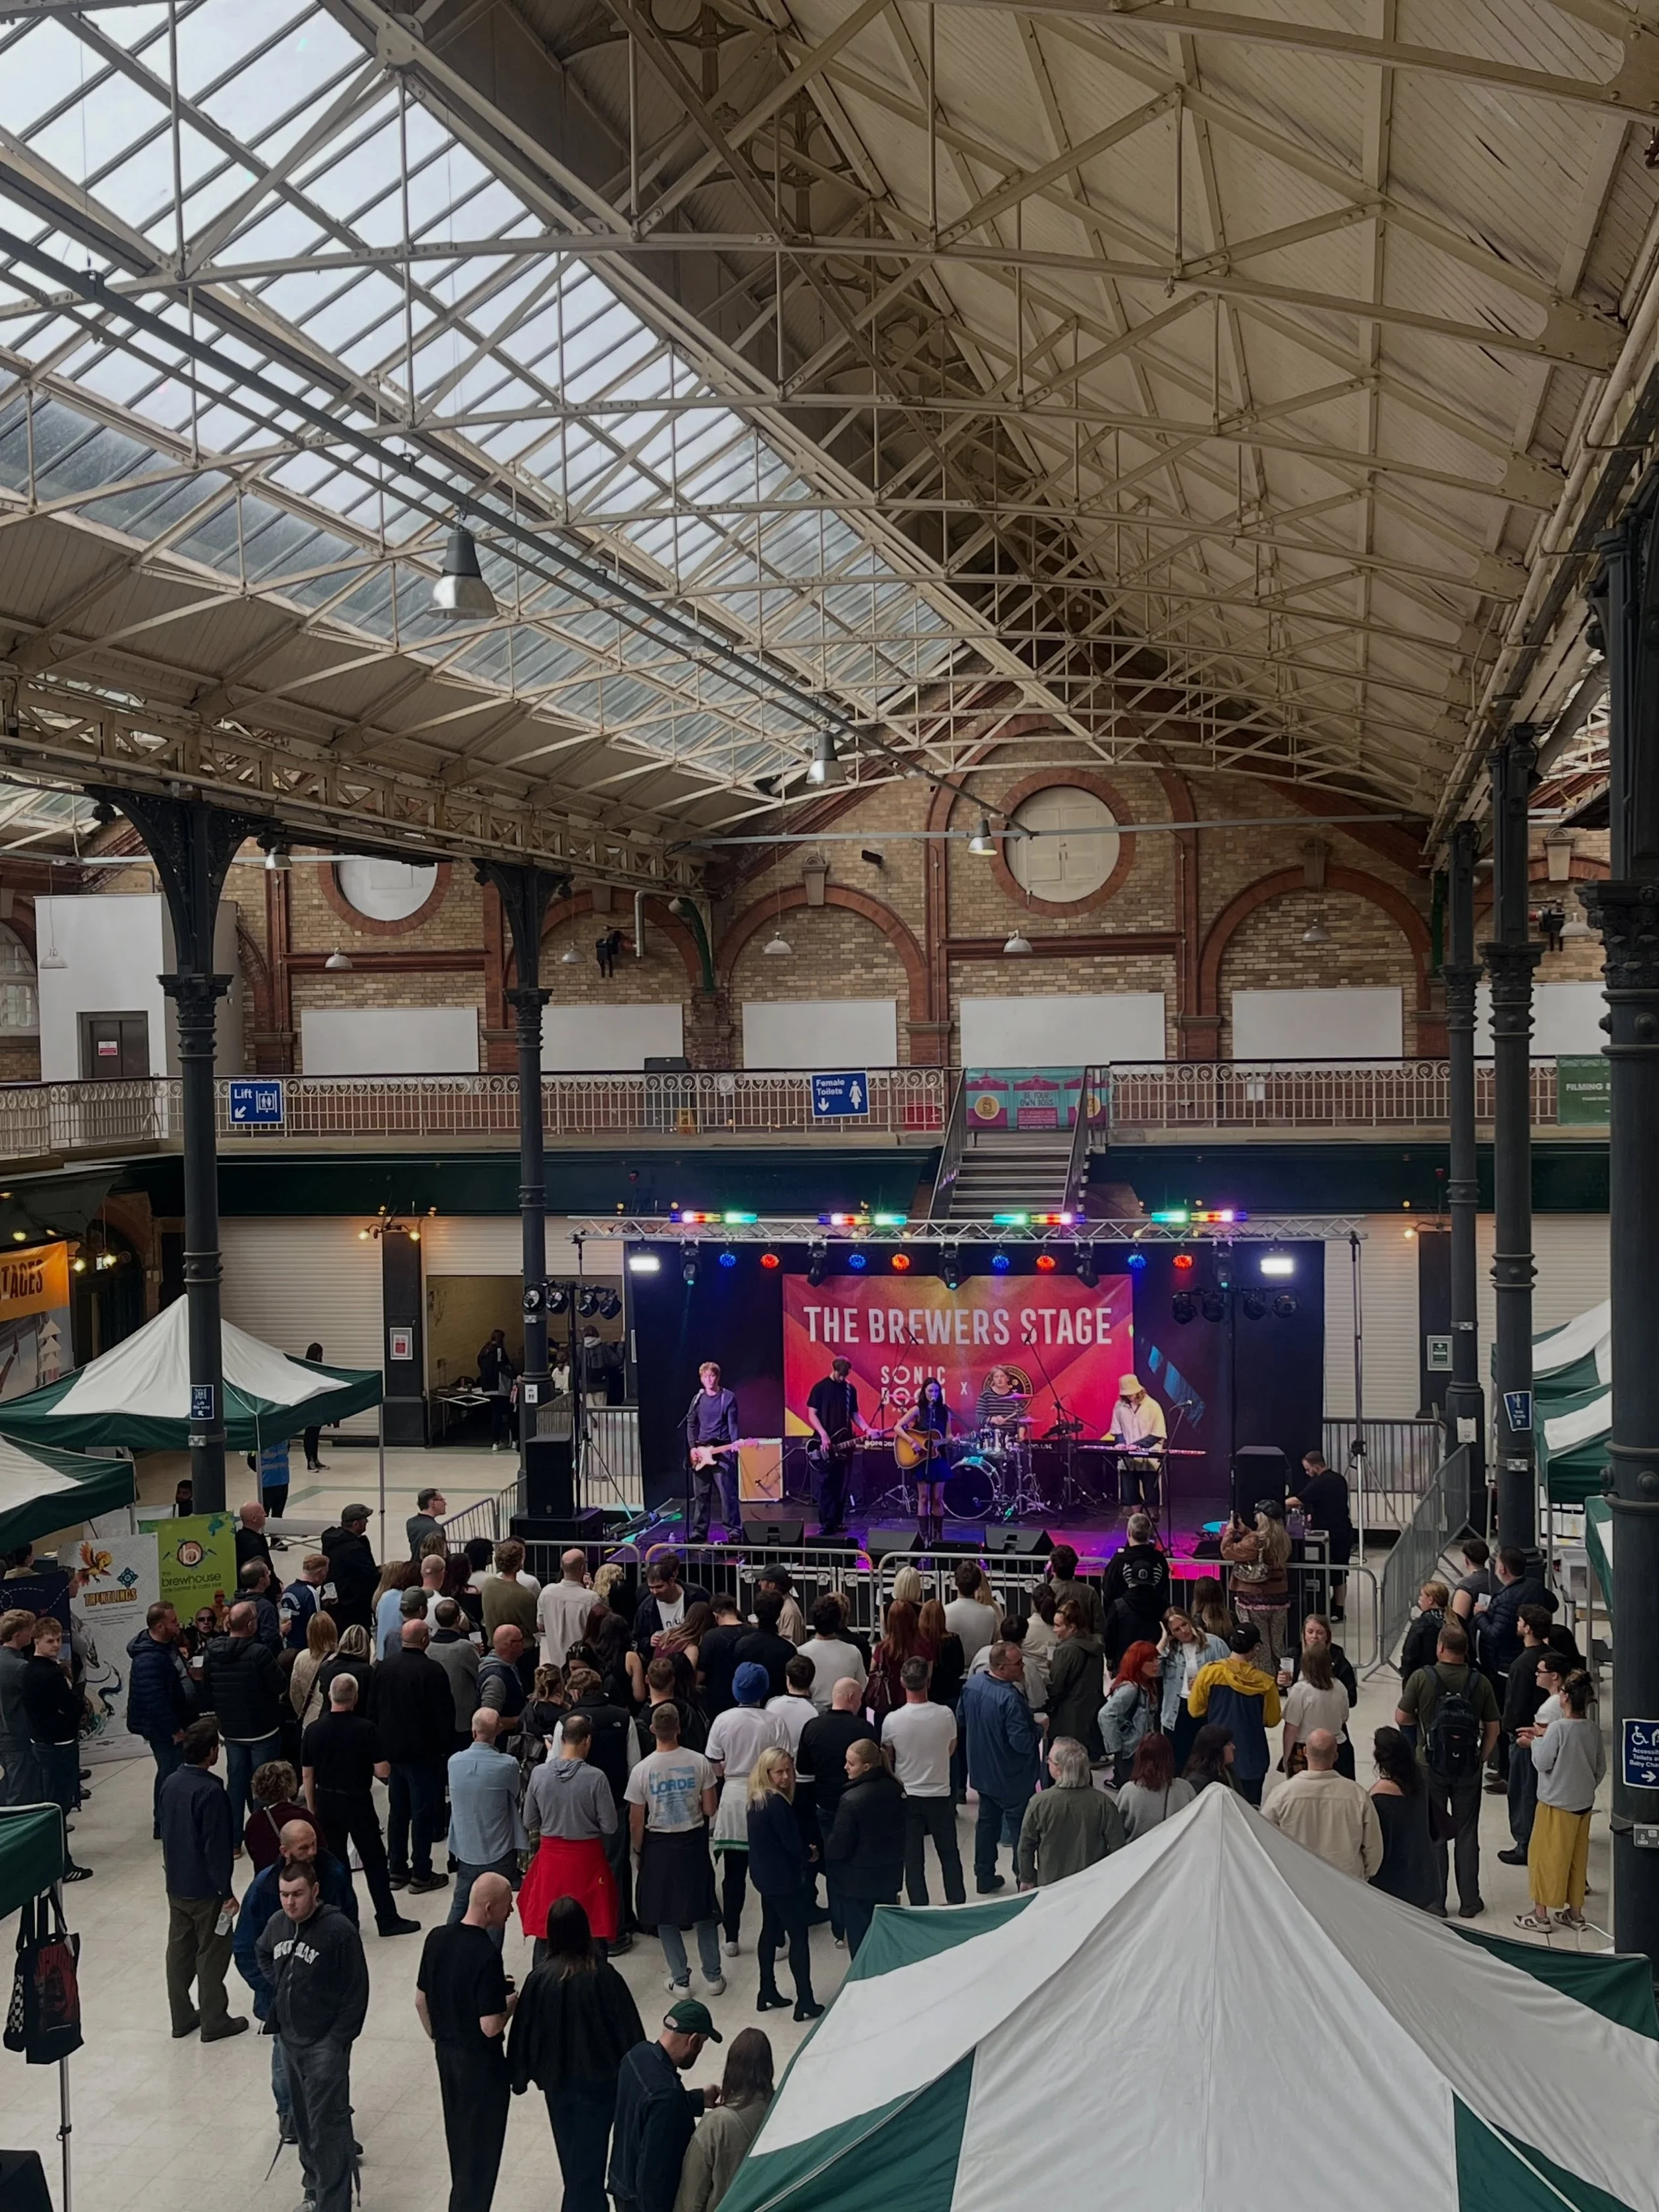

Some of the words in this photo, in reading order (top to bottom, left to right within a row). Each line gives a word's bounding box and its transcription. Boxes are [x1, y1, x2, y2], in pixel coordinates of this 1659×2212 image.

[816, 1078, 845, 1087] Female
[1566, 1082, 1603, 1091] FILMING
[234, 1088, 252, 1099] Lift
[0, 1258, 43, 1299] TAGES
[803, 1307, 859, 1343] THE
[868, 1308, 1010, 1345] BREWERS
[1020, 1307, 1112, 1345] STAGE
[881, 1365, 946, 1384] SONIC
[161, 1573, 222, 1587] brewhouse
[650, 1777, 696, 1795] LORDE
